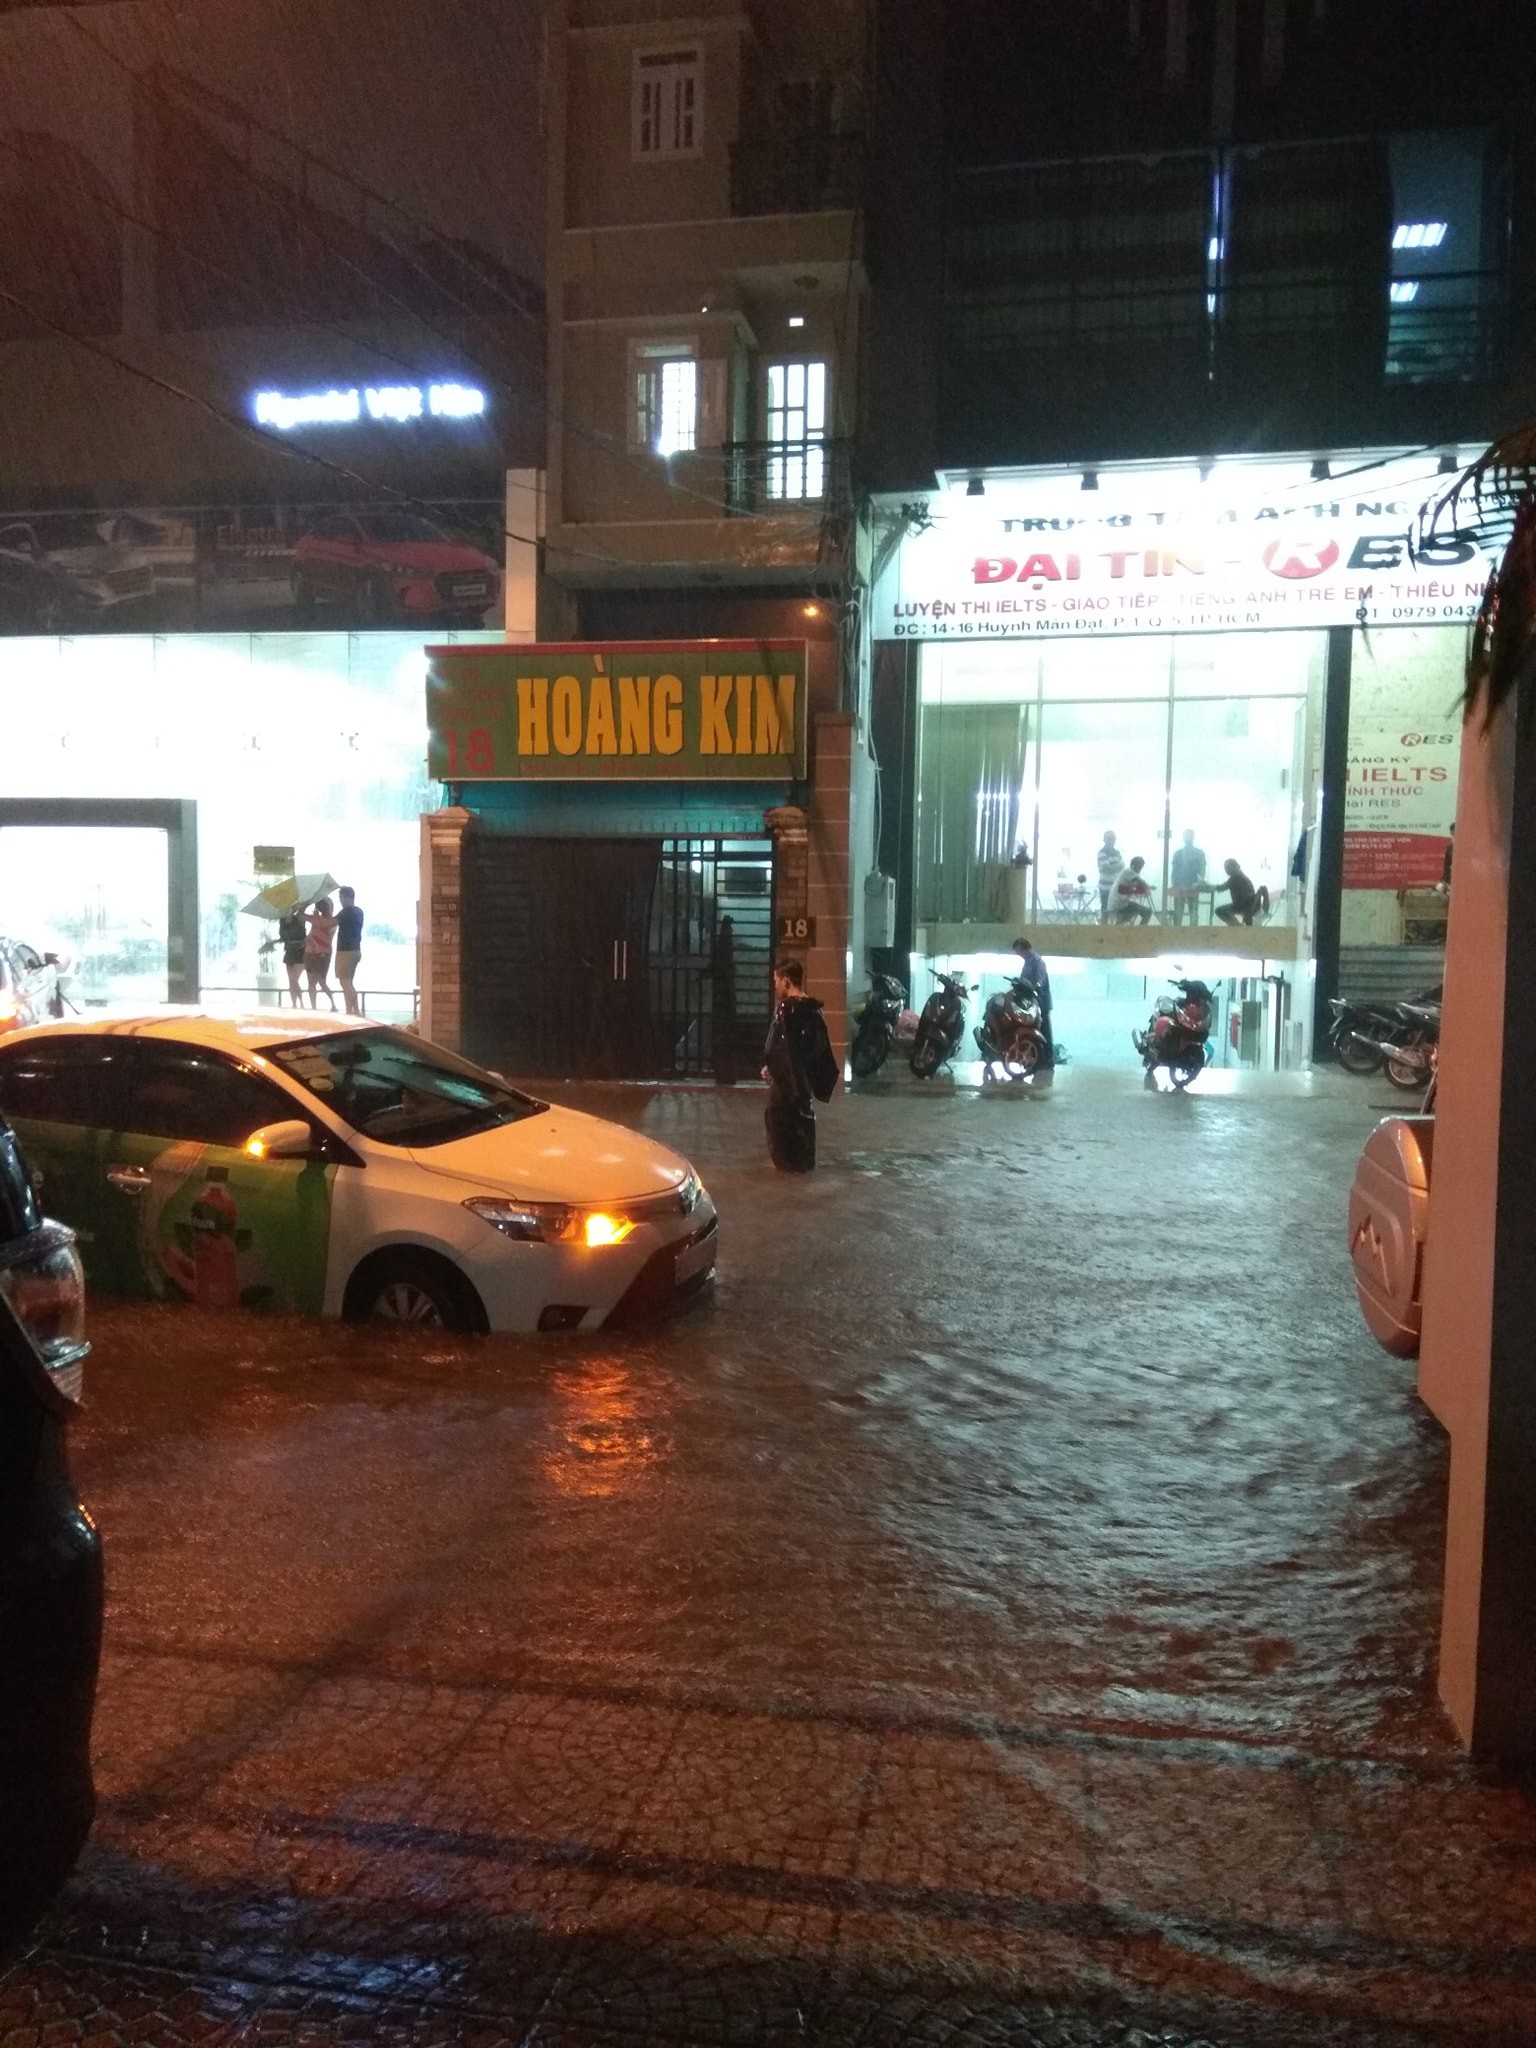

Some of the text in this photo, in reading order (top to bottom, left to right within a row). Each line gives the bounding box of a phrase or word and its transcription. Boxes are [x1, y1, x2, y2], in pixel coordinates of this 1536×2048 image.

[970, 552, 1081, 590] ĐẠI
[893, 599, 956, 620] LUYỆN
[961, 597, 991, 615] THI
[996, 596, 1048, 613] IELTS
[1062, 597, 1110, 612] GIAO
[1246, 590, 1288, 604] ANH
[1344, 585, 1374, 601] EM
[1392, 605, 1437, 619] 0979
[516, 654, 797, 757] HOÀNG KIM
[443, 727, 496, 775] 18
[1362, 766, 1448, 782] IELTS
[784, 918, 808, 938] 18
